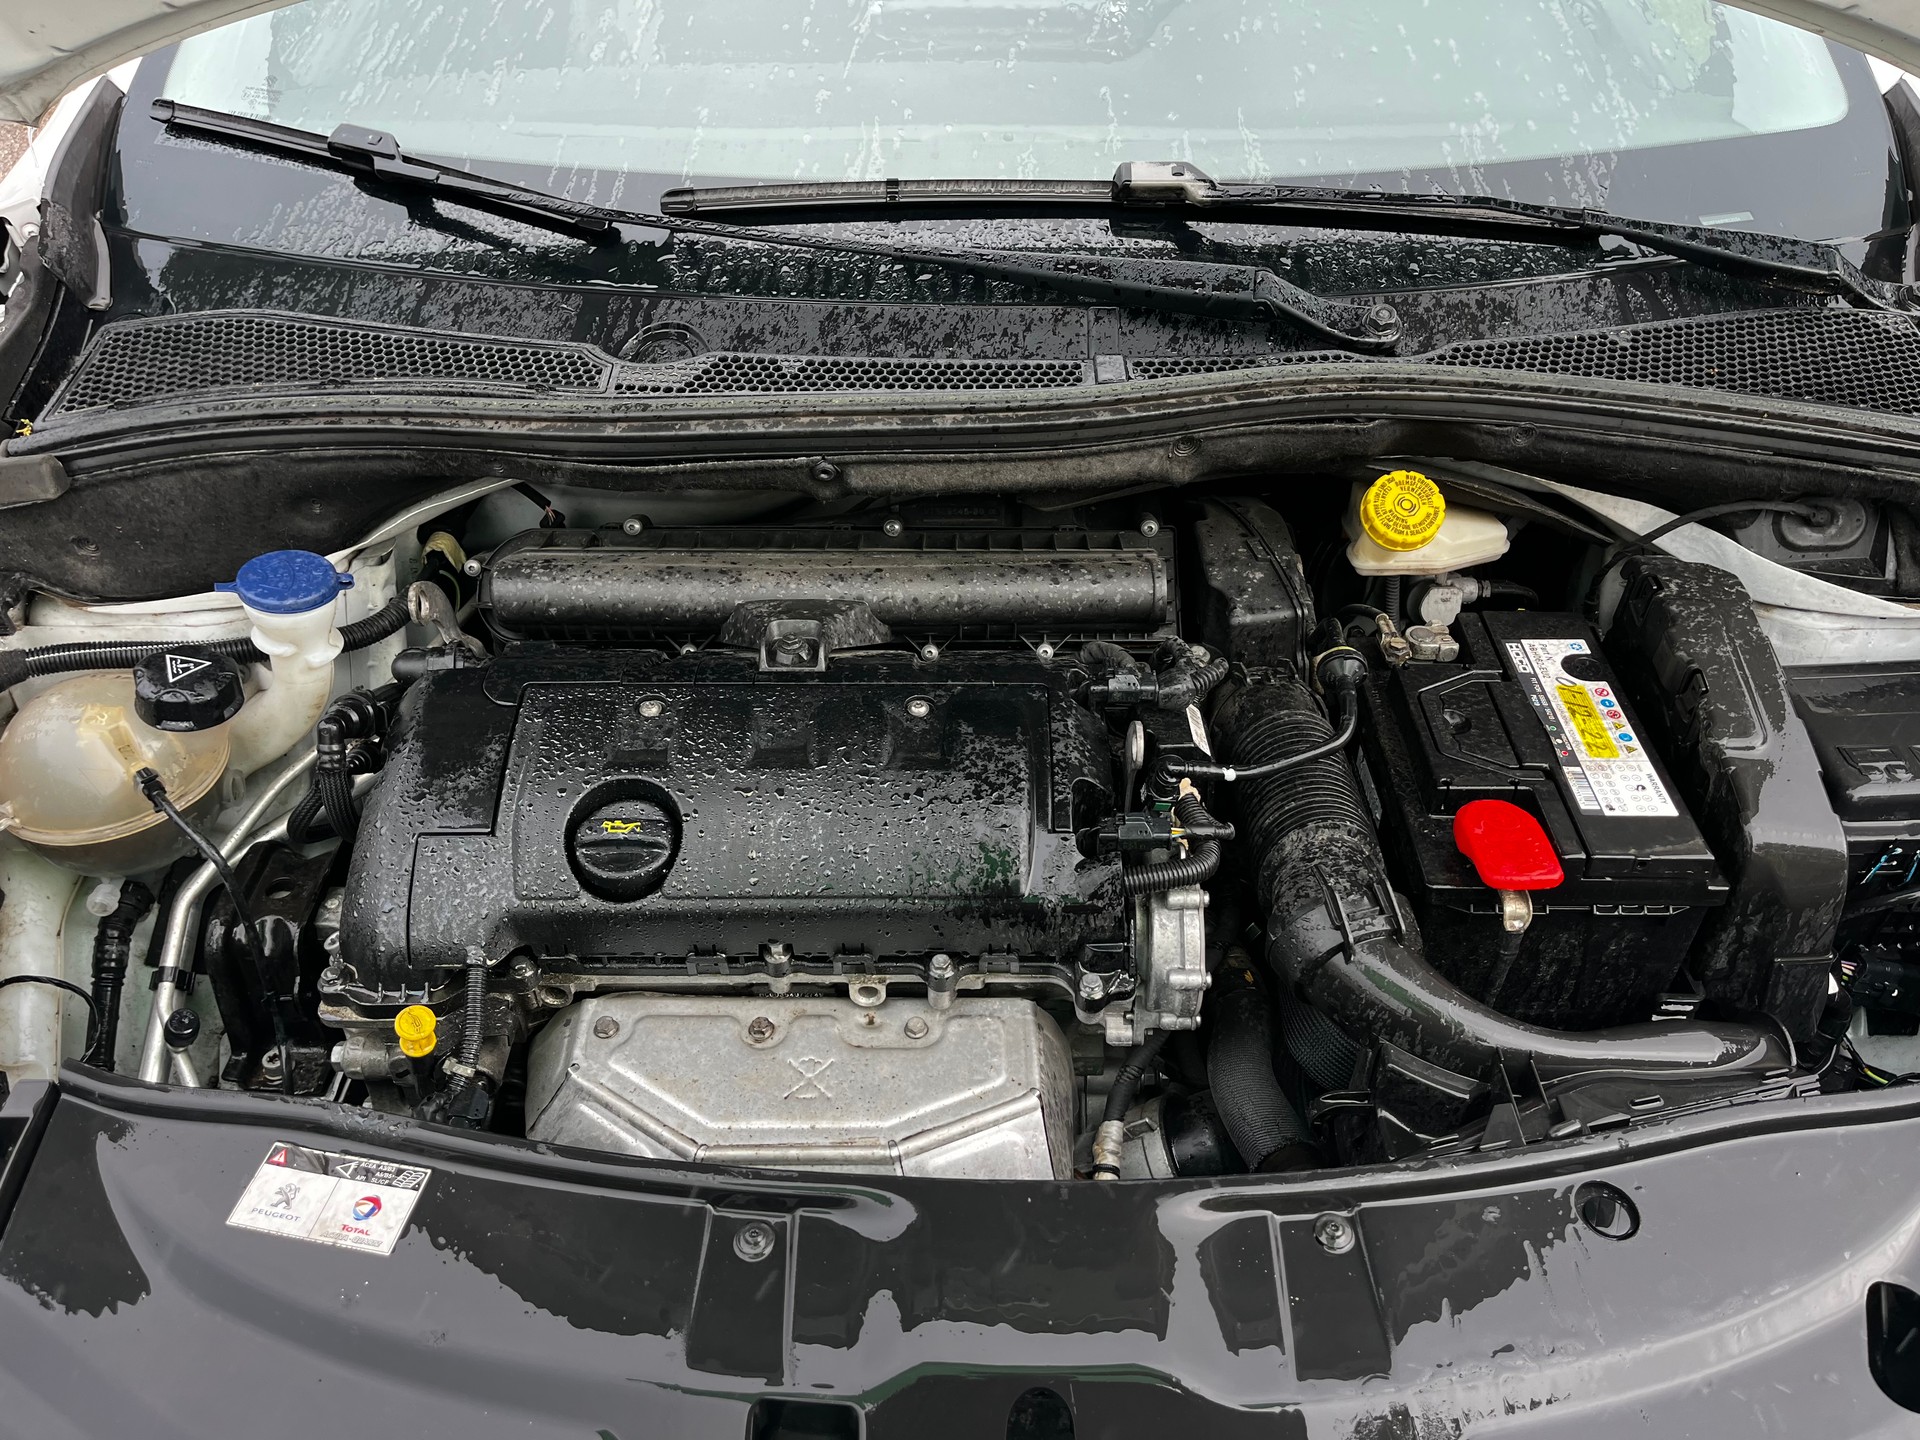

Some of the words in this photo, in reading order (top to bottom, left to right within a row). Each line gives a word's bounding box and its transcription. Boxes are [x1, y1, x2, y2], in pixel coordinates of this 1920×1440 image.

[1381, 486, 1392, 500] CLEAN
[1393, 521, 1411, 530] BEFORE
[1388, 509, 1408, 524] WARNING
[1410, 527, 1427, 536] SEALED
[1646, 772, 1669, 806] WARRANTY
[251, 1207, 301, 1222] PEUGEOT
[341, 1223, 371, 1236] TOTAL
